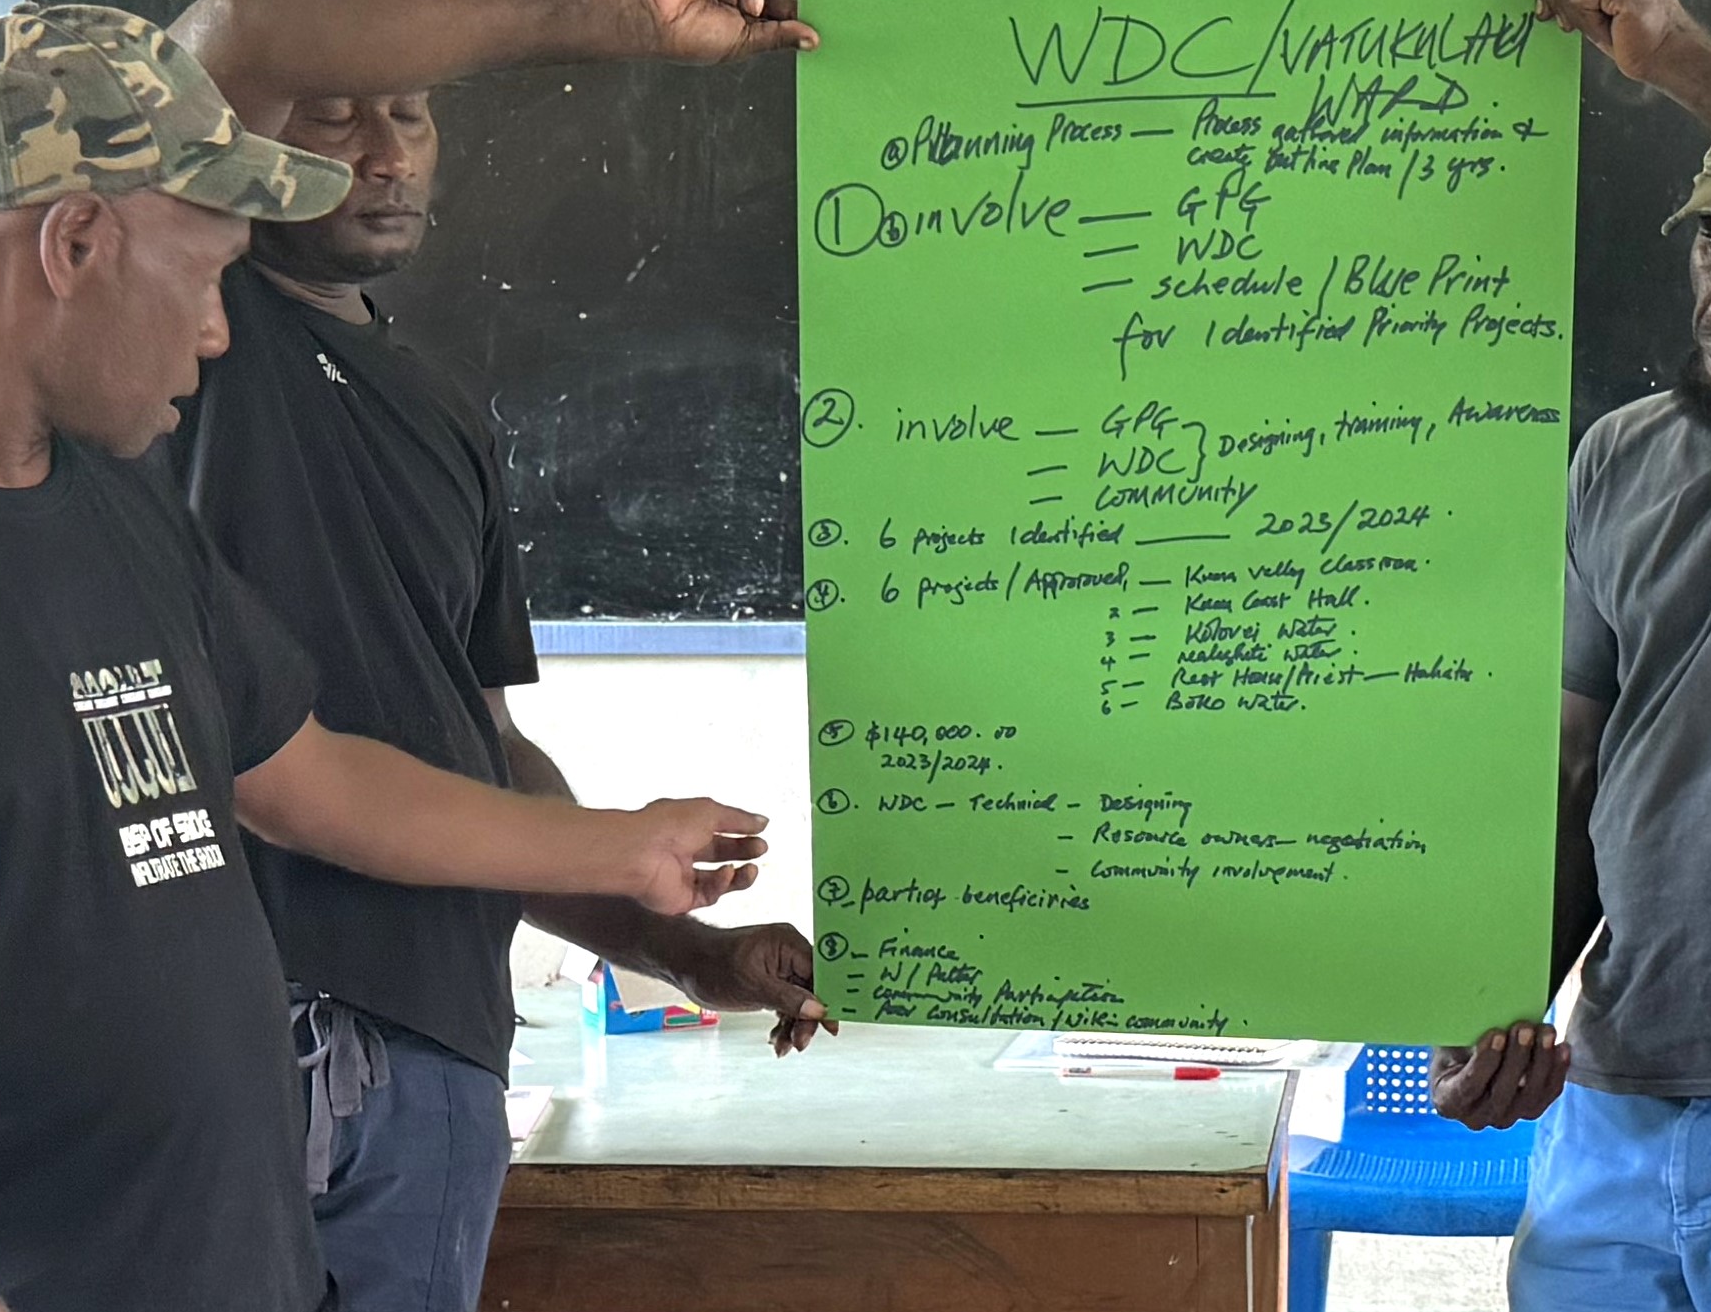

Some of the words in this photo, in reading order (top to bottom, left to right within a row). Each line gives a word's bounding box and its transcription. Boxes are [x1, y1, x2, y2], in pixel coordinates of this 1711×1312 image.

[1177, 228, 1264, 265] WDC
[1151, 264, 1304, 300] schedule
[896, 404, 1020, 443] involve
[1101, 400, 1180, 440] GPG
[1097, 446, 1187, 478] WDC
[878, 794, 928, 812] WDC
